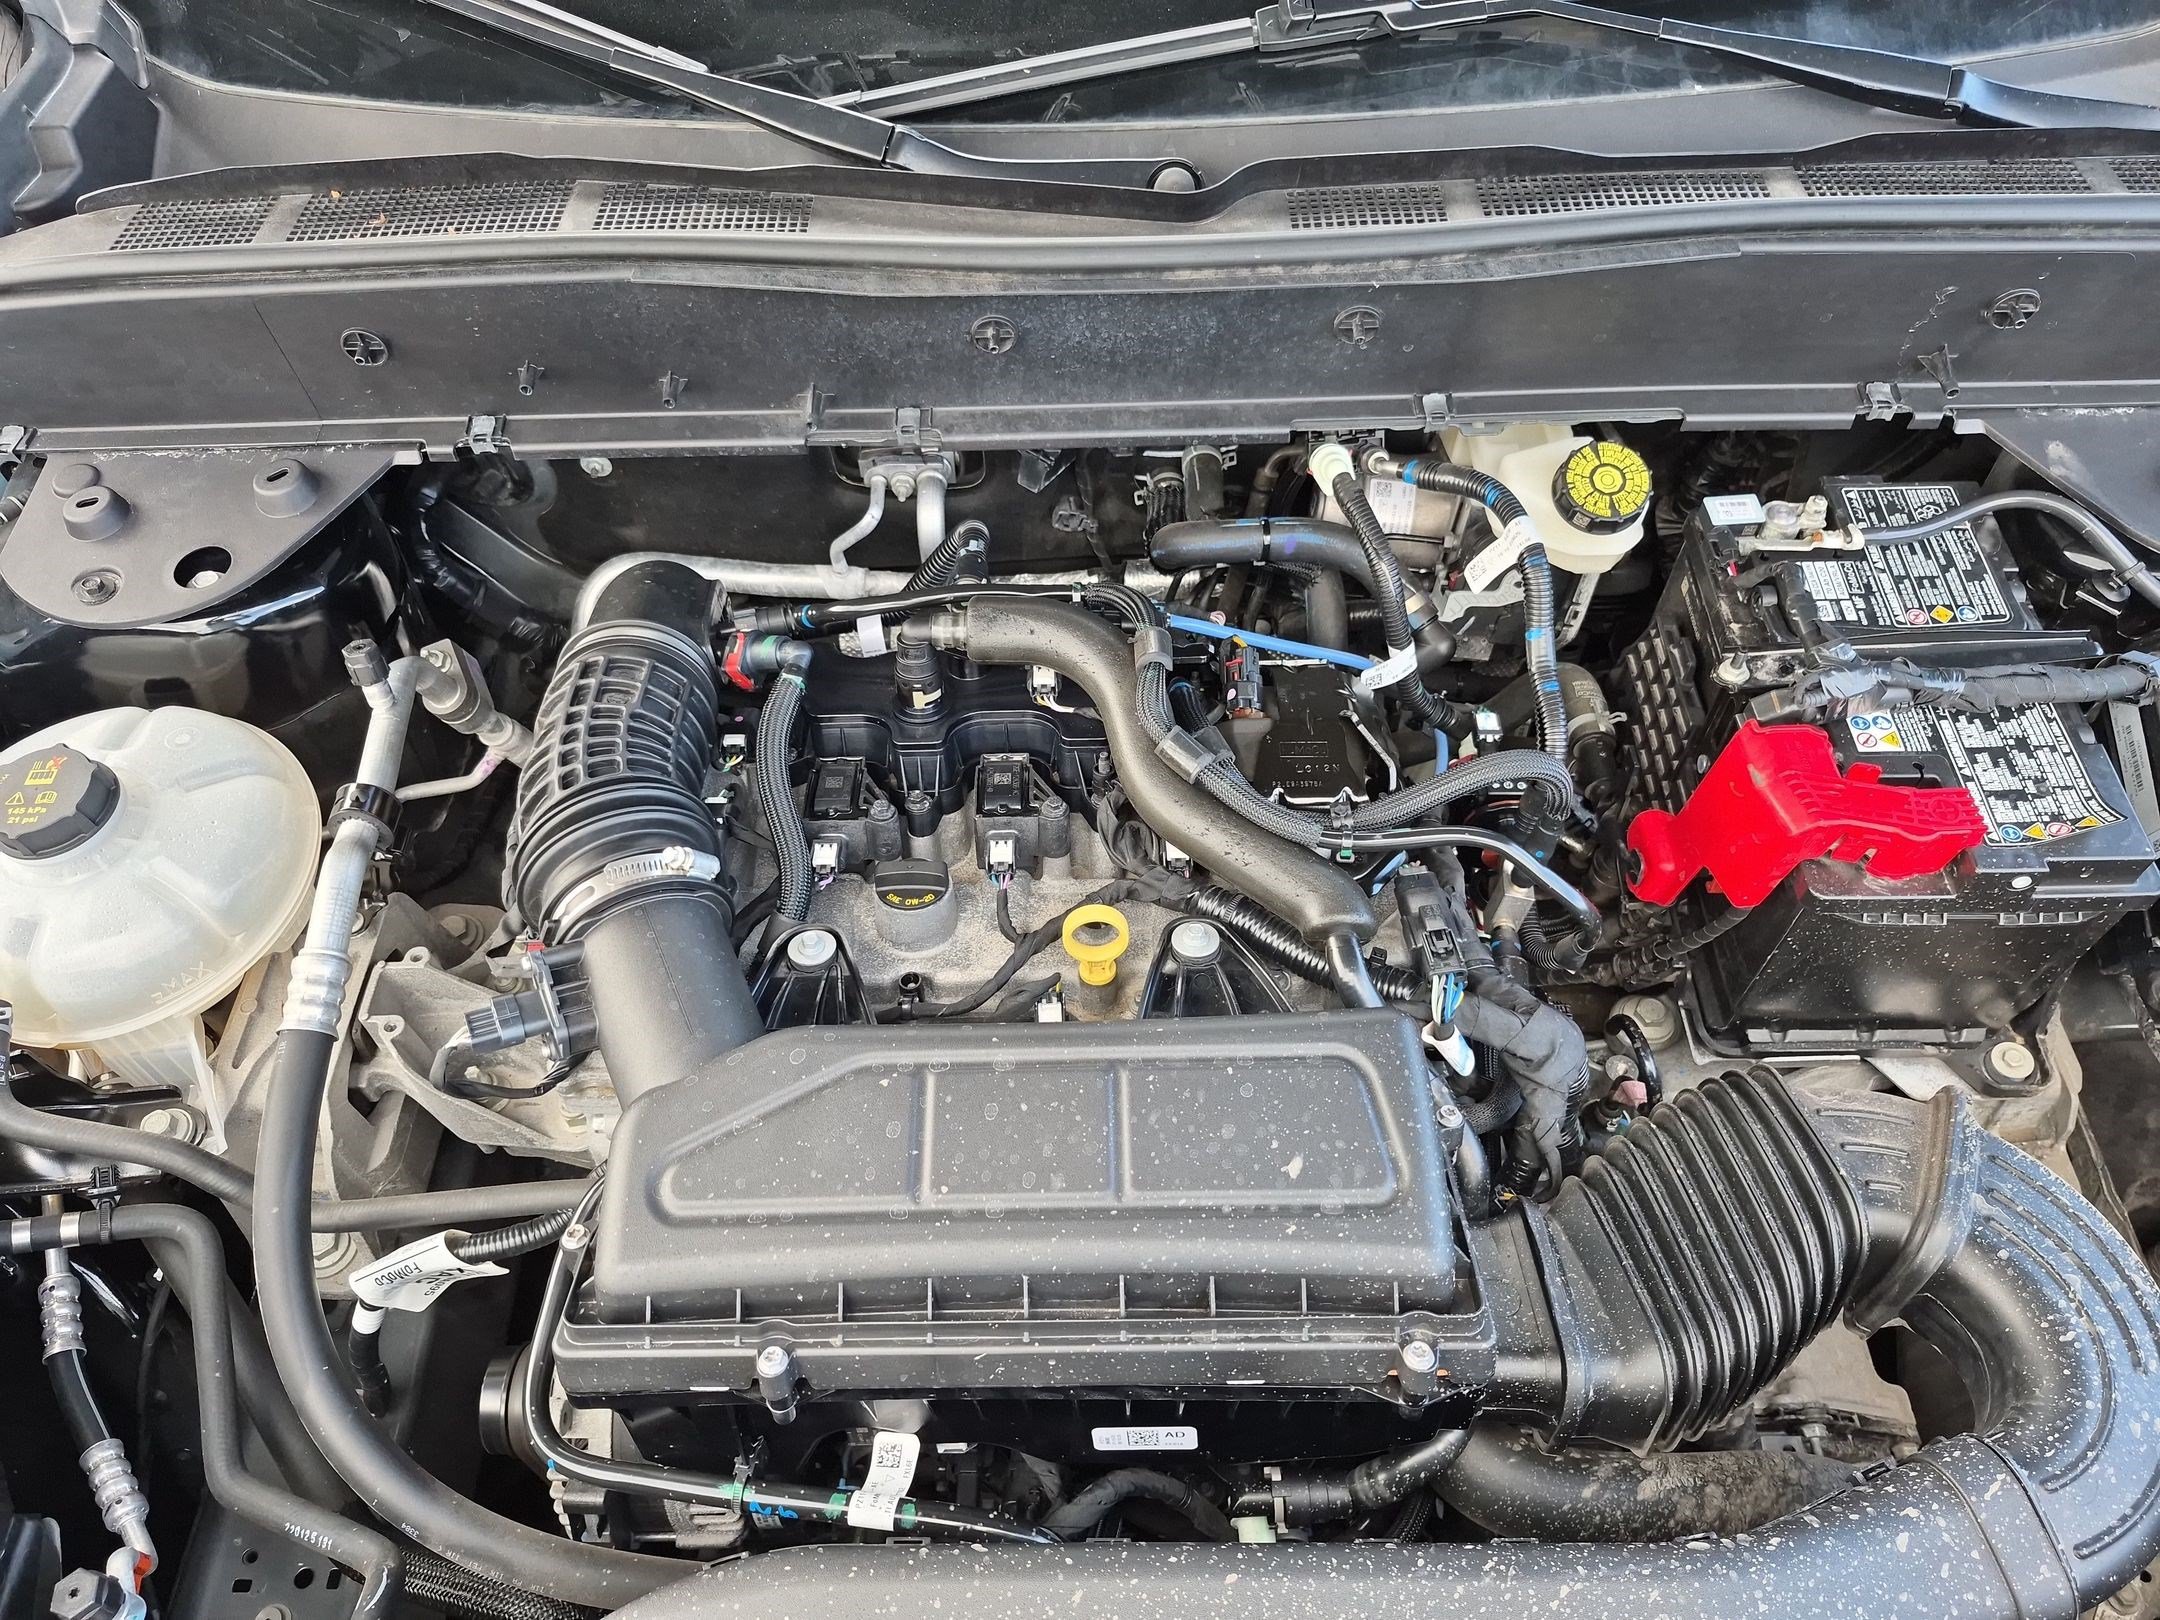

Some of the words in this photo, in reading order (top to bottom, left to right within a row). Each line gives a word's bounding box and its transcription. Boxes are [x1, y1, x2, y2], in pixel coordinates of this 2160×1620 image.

[1843, 562, 1860, 592] FoMoCo
[7, 807, 26, 815] 145
[27, 806, 48, 814] kPa
[22, 816, 38, 825] psi
[886, 893, 902, 904] SAE
[904, 894, 936, 906] 0W-20
[374, 1262, 423, 1287] FoMoCo
